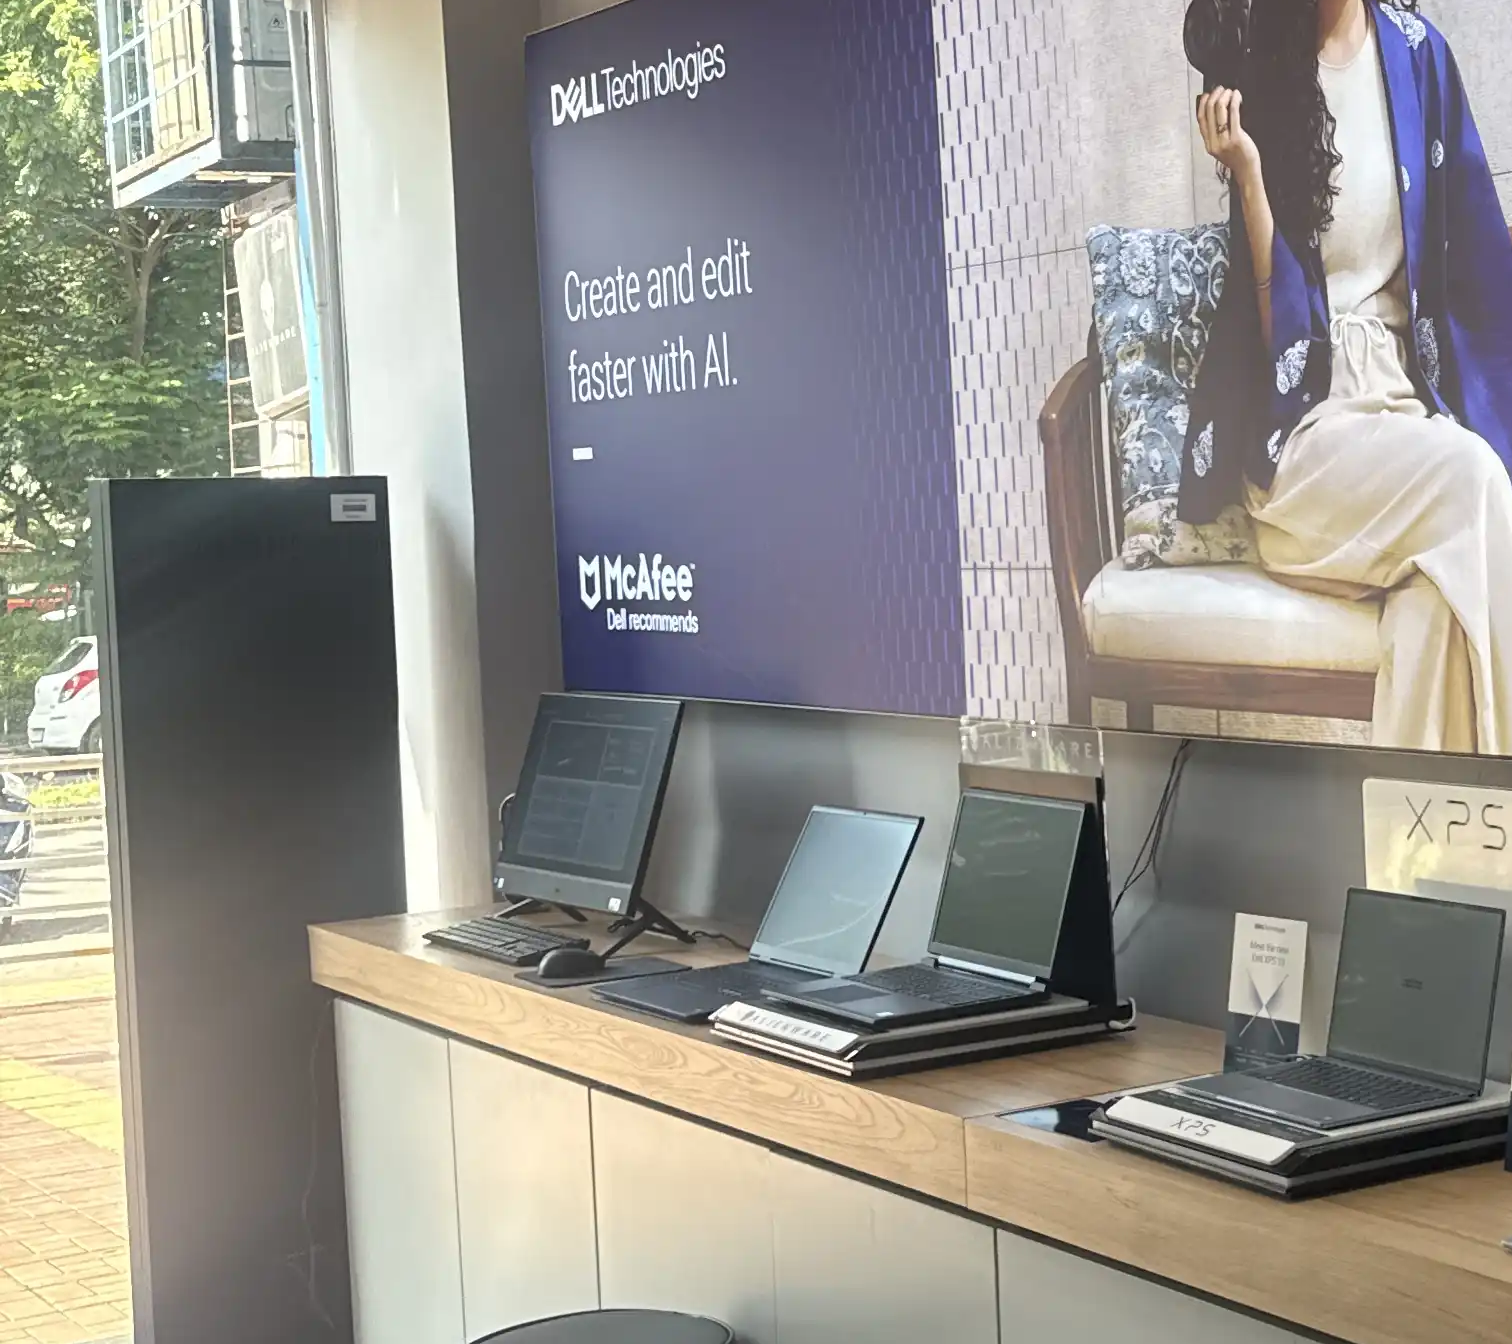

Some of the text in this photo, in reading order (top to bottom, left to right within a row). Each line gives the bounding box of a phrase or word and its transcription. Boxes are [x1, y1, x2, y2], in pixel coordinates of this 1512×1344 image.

[551, 40, 727, 127] DELL Technologies
[564, 237, 753, 322] Create and edit
[568, 331, 738, 403] faster with AI.
[603, 552, 694, 602] McAfee
[606, 607, 700, 634] Dell recommends
[1405, 794, 1507, 851] XPS
[1170, 1115, 1217, 1137] XPS
